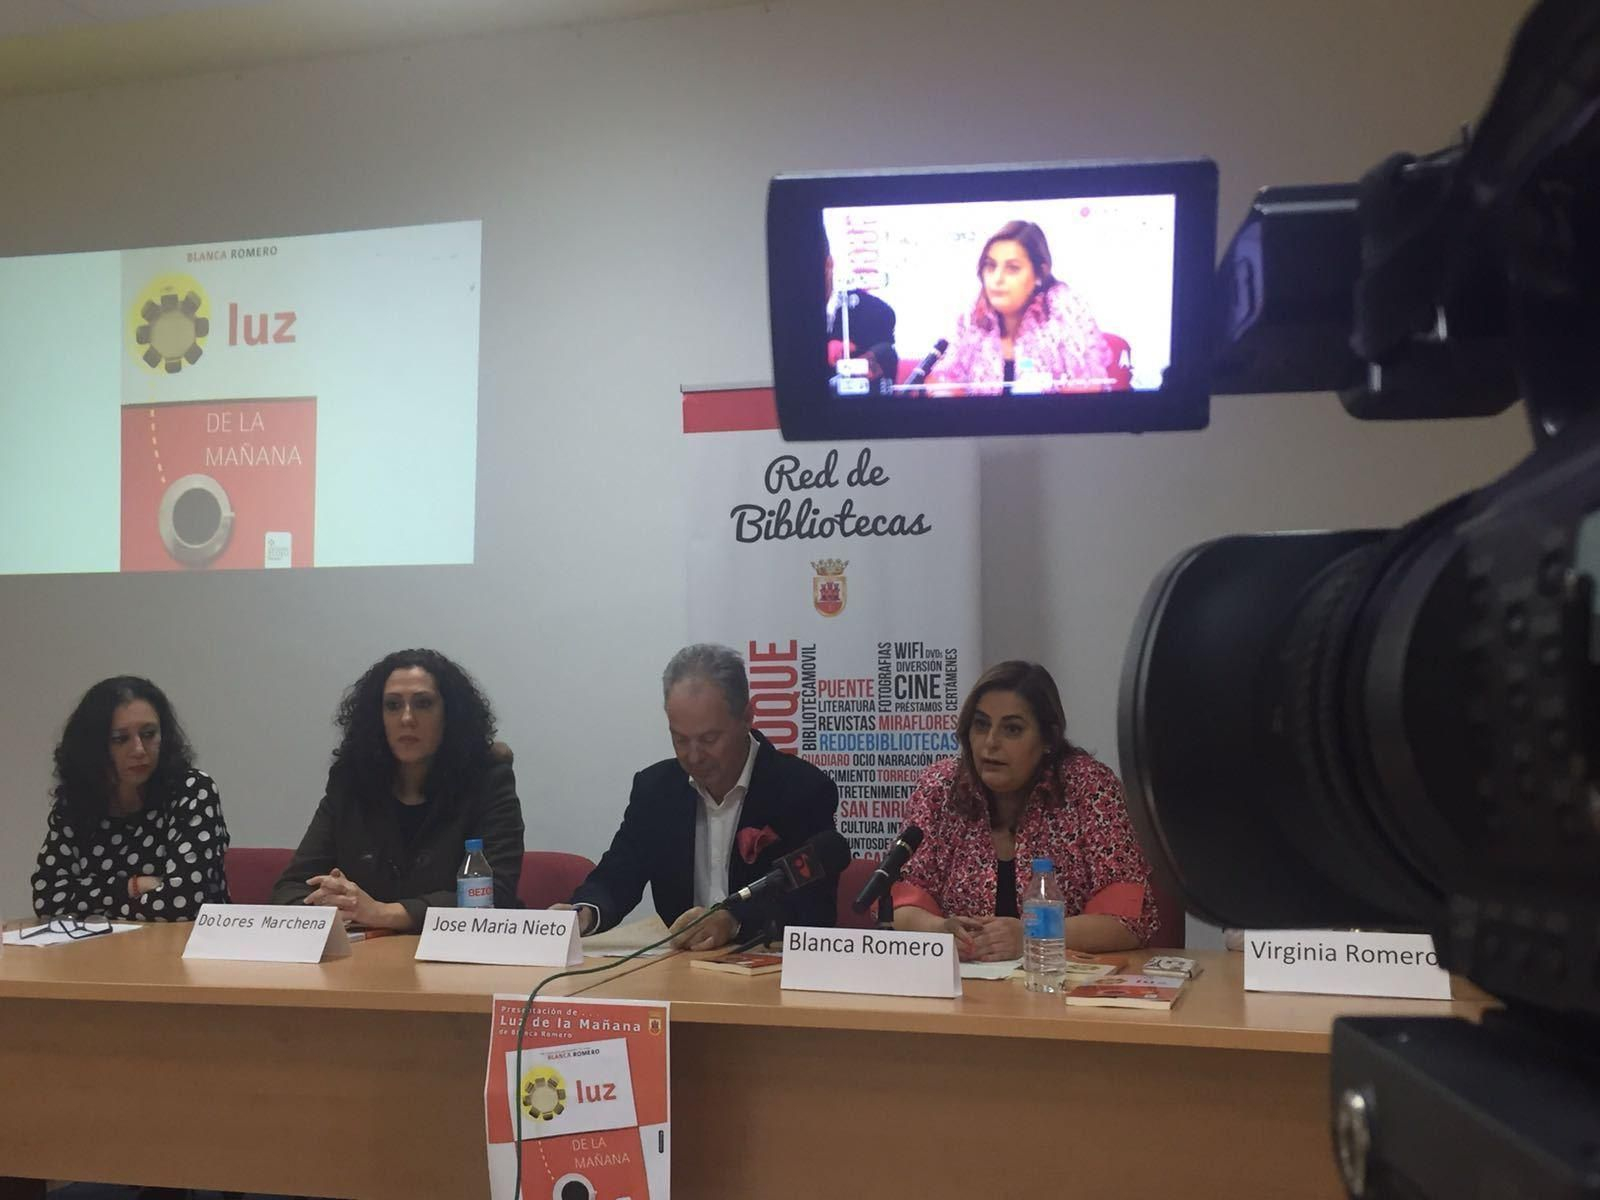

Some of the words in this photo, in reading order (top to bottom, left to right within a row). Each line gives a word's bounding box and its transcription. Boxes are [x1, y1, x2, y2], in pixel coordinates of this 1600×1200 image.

[186, 250, 227, 263] BLANCA
[231, 246, 278, 259] ROMERO
[228, 302, 297, 346] luz
[206, 412, 231, 433] DE
[239, 411, 265, 432] LA
[205, 442, 302, 467] MAÑANA
[764, 449, 839, 495] Red
[846, 447, 890, 487] de
[730, 497, 932, 543] Bibliotecas
[894, 641, 924, 660] WIFI
[896, 658, 943, 673] DIVERSIÓN
[877, 641, 892, 713] FOTOGRAFIAS
[894, 673, 942, 700] CINE
[943, 648, 958, 712] CERTÁMENES
[749, 639, 800, 756] OQUE
[801, 643, 817, 751] BIBLIOTECAMOVIL
[818, 679, 875, 699] PUENTE
[818, 700, 876, 713] LITERATURA
[894, 701, 943, 713] PRÉSTAMOS
[818, 715, 876, 731] REVISTAS
[878, 714, 958, 731] MIRAFLORES
[819, 732, 960, 752] REDDEBIBLIOTECAS
[852, 753, 876, 767] OCIO
[877, 751, 933, 767] NARRACIÓN
[876, 769, 920, 783] TORREG
[840, 800, 868, 818] SAN
[872, 800, 905, 818] ENRI
[840, 821, 885, 834] CULTURA
[198, 913, 254, 929] Dolores
[260, 914, 326, 931] Marchena
[432, 916, 467, 933] Jose
[471, 918, 518, 935] Maria
[522, 920, 567, 937] Nieto
[788, 932, 855, 953] Blanca
[861, 935, 945, 958] Romero
[1250, 941, 1337, 965] Virginia
[1346, 944, 1438, 966] Romero
[511, 1029, 538, 1037] Blnca
[532, 1017, 550, 1028] de
[557, 1017, 571, 1029] la
[579, 1018, 641, 1032] Mañana
[572, 1049, 600, 1057] ROMERO
[576, 1080, 617, 1104] luz
[572, 1138, 588, 1151] DE
[591, 1137, 607, 1149] LA
[574, 1152, 631, 1169] MAÑANA
